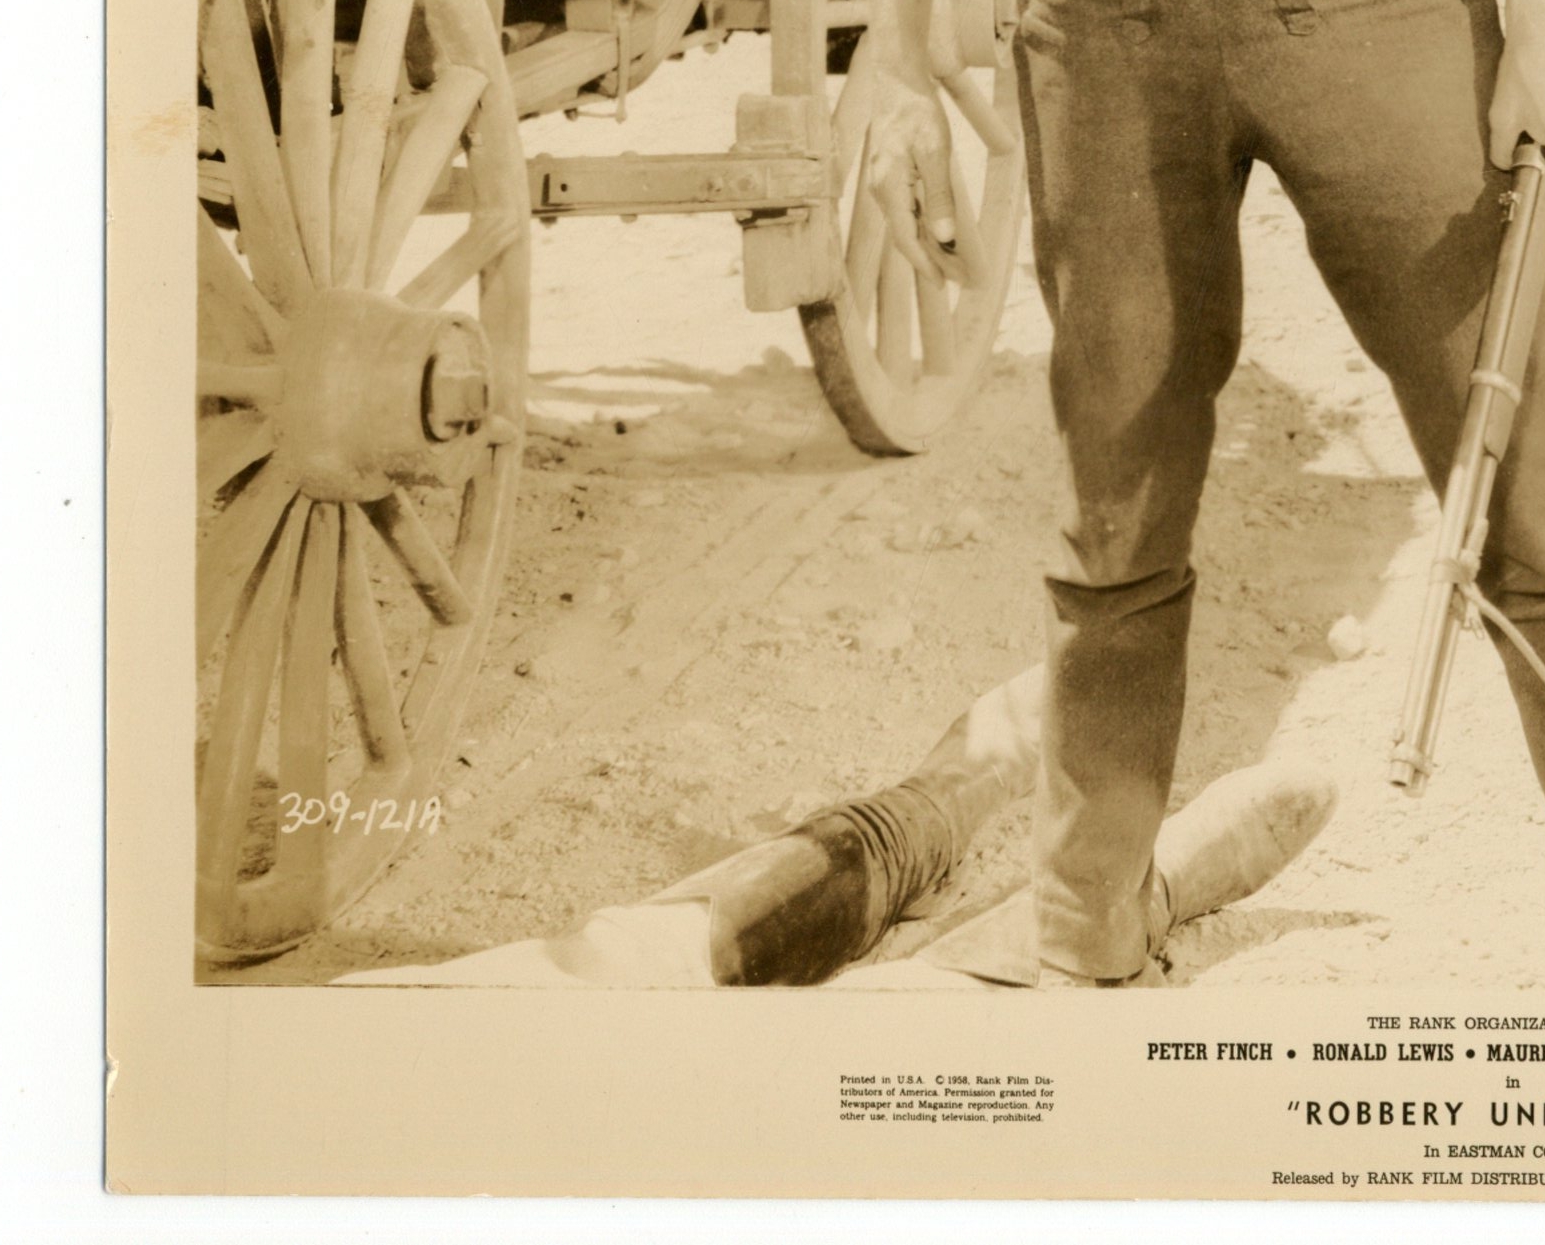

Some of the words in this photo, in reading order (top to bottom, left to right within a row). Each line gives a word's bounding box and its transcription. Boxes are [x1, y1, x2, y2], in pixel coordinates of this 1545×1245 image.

[1366, 1016, 1401, 1030] THE
[1408, 1016, 1457, 1030] RANK
[1147, 1042, 1208, 1061] PETER
[1216, 1042, 1273, 1061] FINCH
[1312, 1042, 1387, 1062] RONALD
[1397, 1042, 1455, 1062] LEWIS
[839, 1074, 876, 1085] Printed
[881, 1076, 892, 1085] in
[947, 1075, 971, 1086] 1958,
[975, 1075, 1002, 1086] Rank
[1006, 1075, 1030, 1086] Film
[1034, 1075, 1055, 1086] Dis-
[1505, 1075, 1521, 1089] in
[839, 1087, 883, 1097] tributors
[885, 1087, 896, 1097] of
[943, 1087, 996, 1098] Permission
[999, 1088, 1037, 1100] granted
[1039, 1087, 1055, 1098] for
[840, 1099, 892, 1111] Newspaper
[895, 1099, 915, 1109] and
[917, 1099, 964, 1112] Magazine
[1034, 1100, 1055, 1112] Any
[839, 1111, 866, 1121] other
[869, 1113, 889, 1122] use,
[892, 1111, 938, 1124] including
[941, 1112, 989, 1123] television,
[992, 1112, 1045, 1125] prohibited.
[1287, 1100, 1464, 1127] "ROBBERY
[1423, 1144, 1441, 1159] In
[1447, 1144, 1527, 1159] EASTMAN
[1271, 1171, 1335, 1185] Released
[1341, 1171, 1360, 1189] by
[1366, 1171, 1415, 1185] RANK
[1421, 1171, 1464, 1185] FILM
